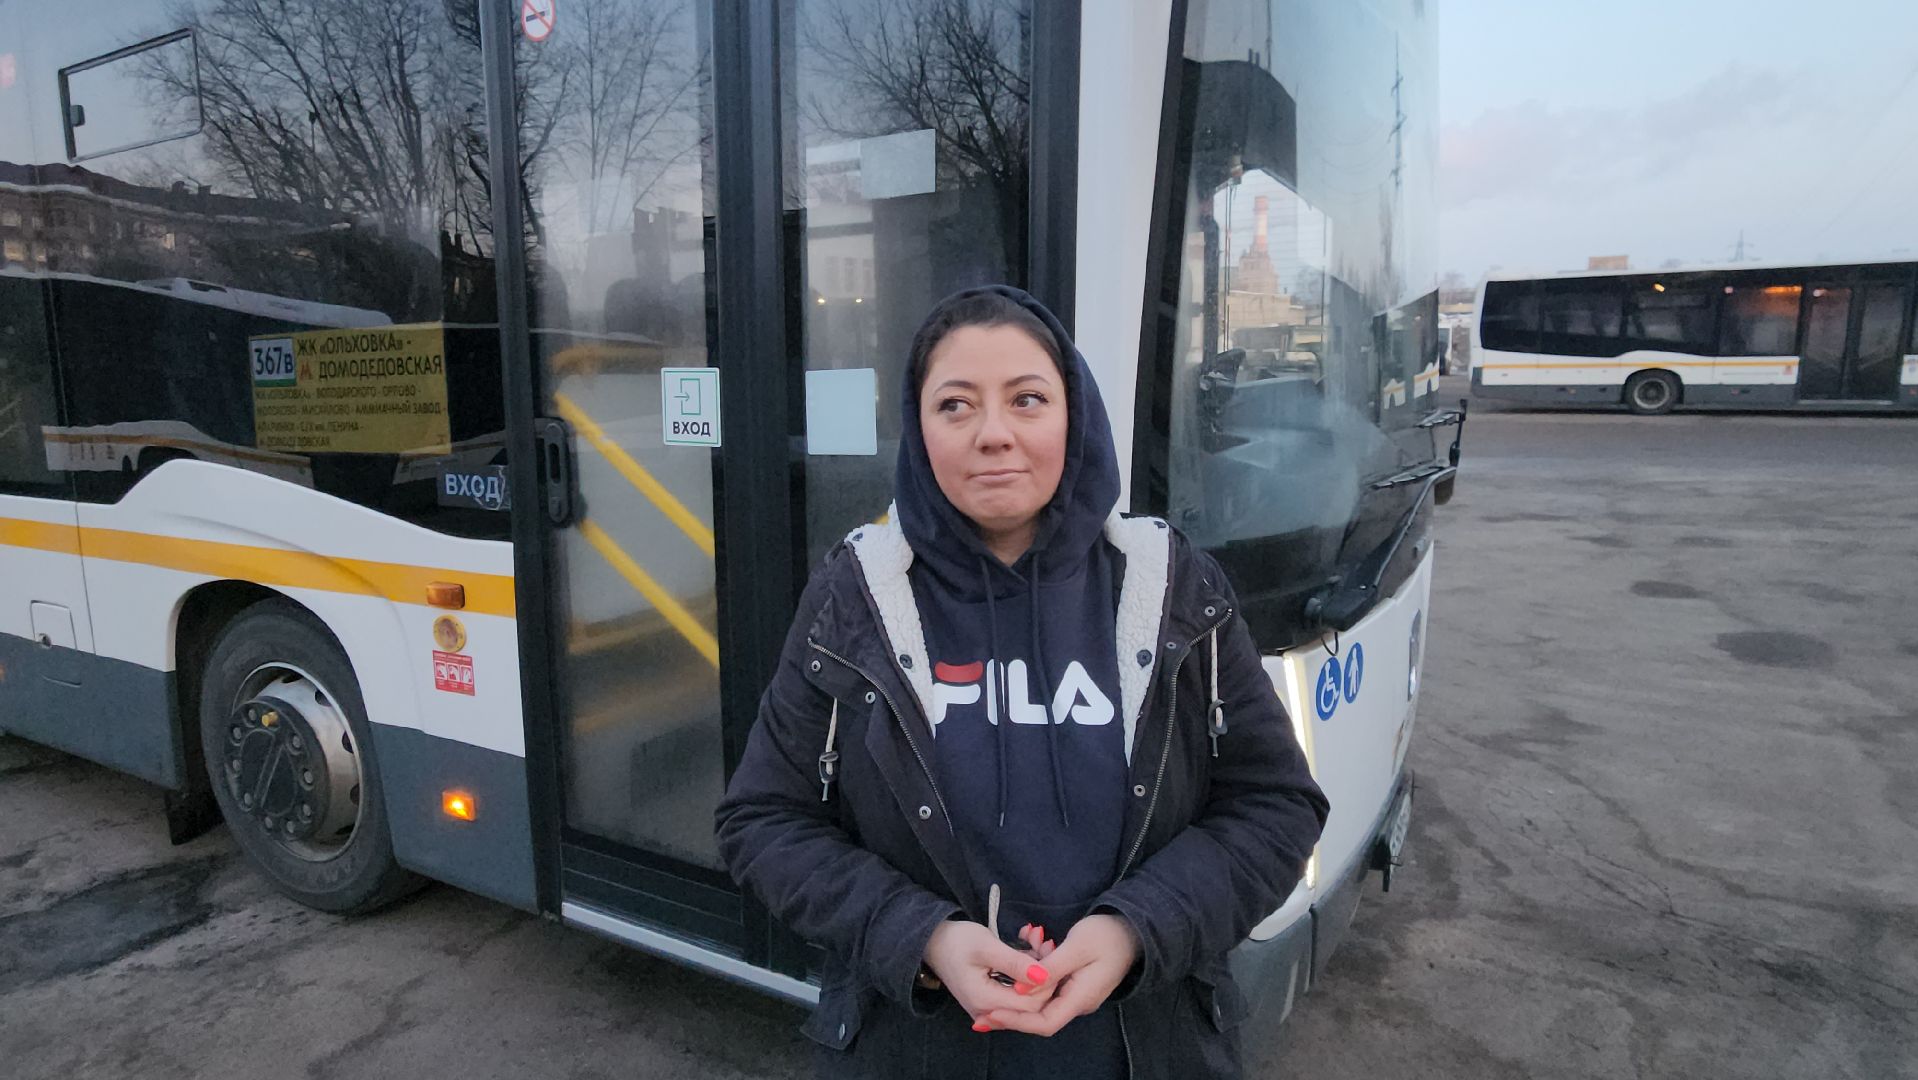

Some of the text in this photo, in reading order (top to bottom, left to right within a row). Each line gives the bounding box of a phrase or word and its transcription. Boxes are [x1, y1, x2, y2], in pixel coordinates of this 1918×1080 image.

[297, 339, 317, 356] ЖК
[320, 333, 403, 355] «ОЛЬХОВКА»
[319, 355, 442, 381] ДОМОДЕДОВСКАЯ
[413, 402, 441, 415] ЗАВОД
[672, 421, 711, 437] ВХОД
[445, 474, 502, 503] ВХОД
[933, 659, 1115, 726] FILA
